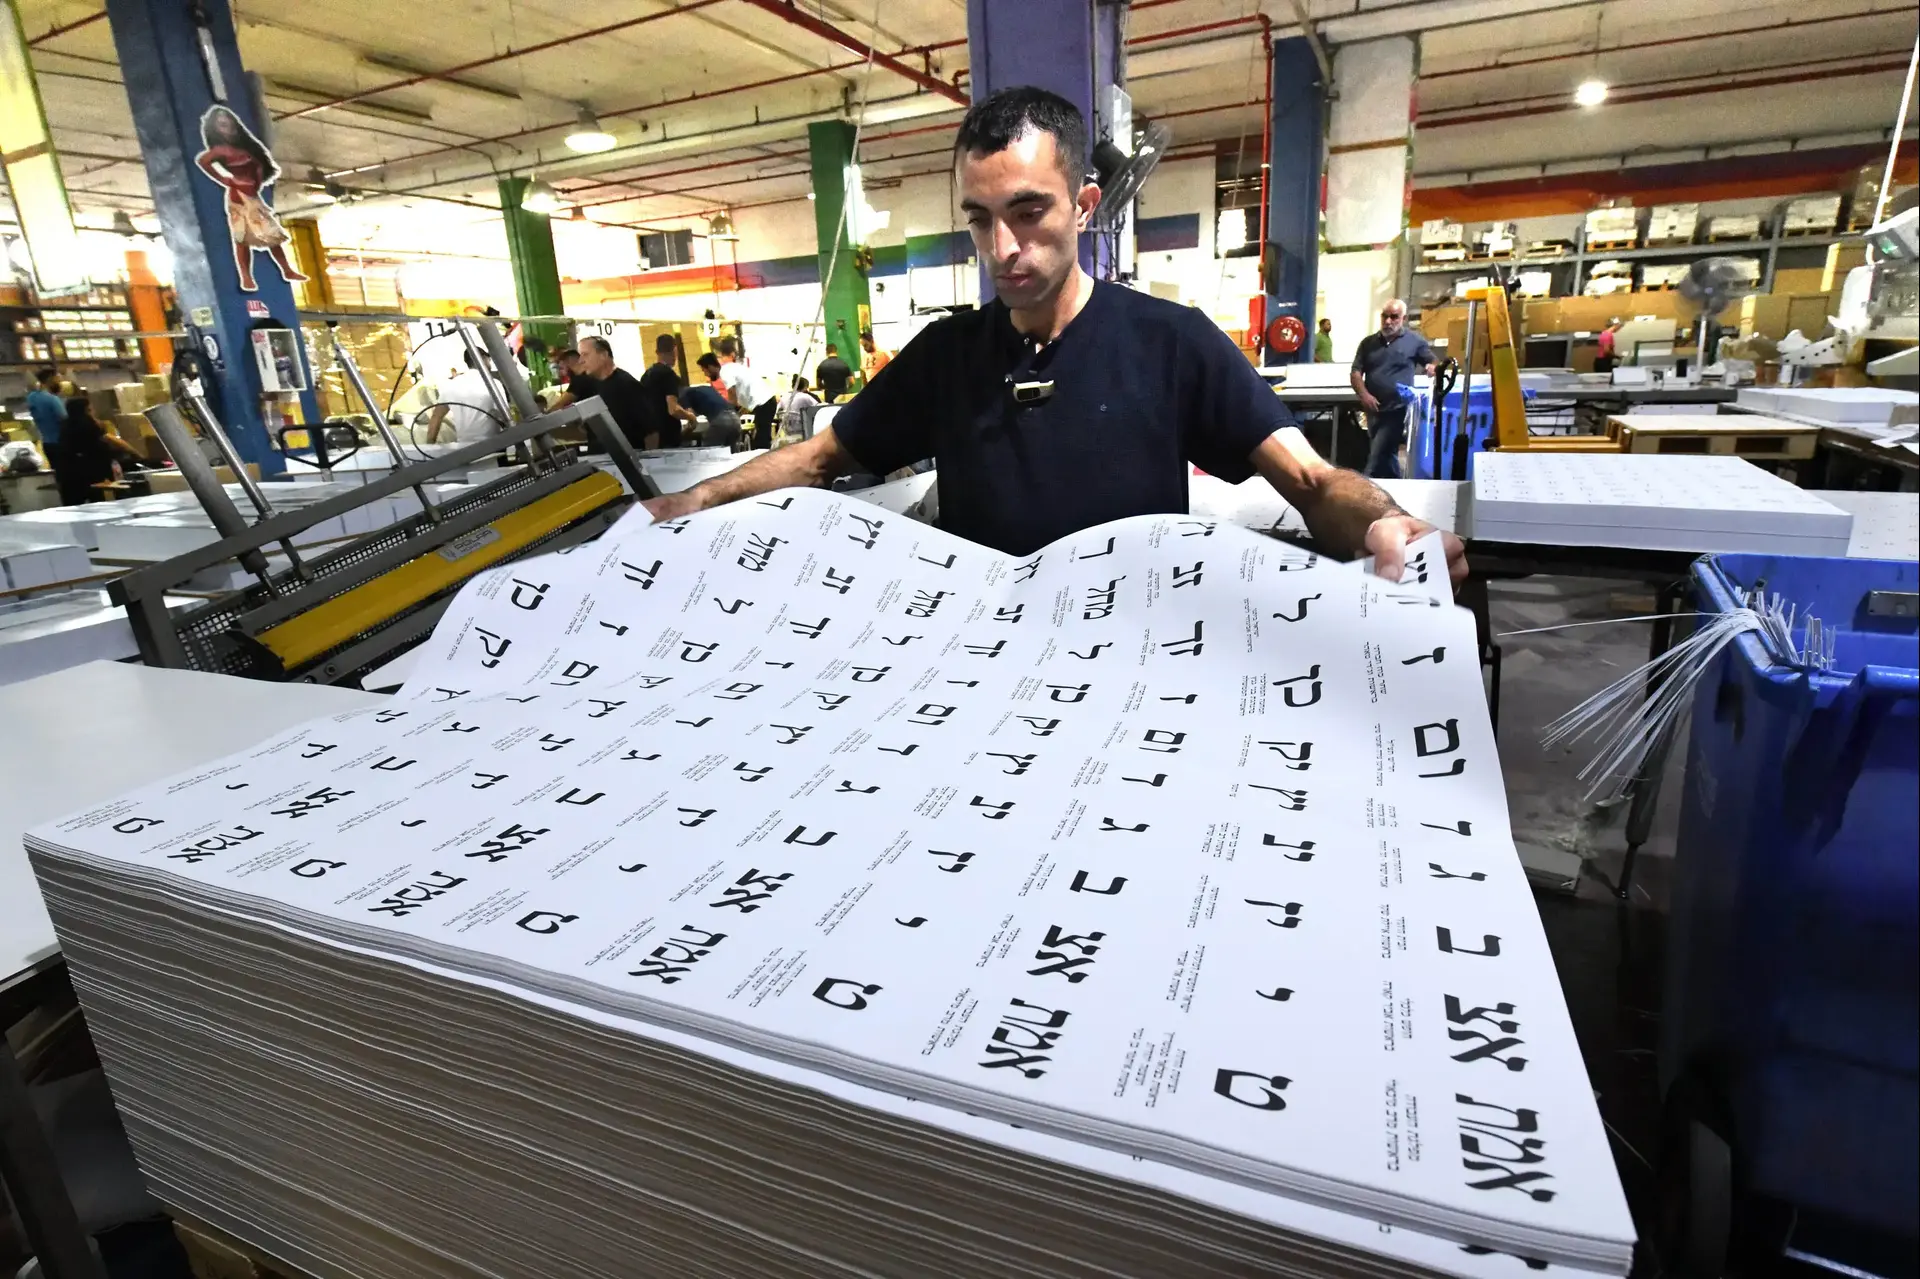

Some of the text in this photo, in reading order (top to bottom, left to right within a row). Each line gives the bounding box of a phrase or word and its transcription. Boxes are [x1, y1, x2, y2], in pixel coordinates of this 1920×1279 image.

[597, 322, 613, 335] 10
[707, 324, 715, 335] 9
[454, 529, 493, 550] POLAR
[737, 533, 789, 572] מחל
[714, 598, 754, 614] ל
[905, 590, 955, 617] מחל
[1083, 575, 1126, 620] מחל
[1273, 593, 1322, 622] ל
[882, 636, 923, 645] ל
[1068, 642, 1113, 659] ל
[1402, 647, 1446, 665] ז
[1046, 684, 1091, 702] כן
[1272, 665, 1322, 707] כן
[1160, 694, 1198, 704] ז
[908, 704, 957, 725] ום
[1016, 716, 1061, 736] יק
[1139, 729, 1187, 753] ום
[1414, 719, 1466, 778] ום
[1258, 741, 1313, 770] יק
[835, 780, 880, 793] ג
[783, 825, 837, 846] ב
[1099, 817, 1150, 832] ג
[290, 859, 347, 878] ט
[1429, 863, 1487, 881] ג
[368, 871, 468, 917] אמת
[709, 868, 794, 913] אצ
[1070, 870, 1128, 895] ב
[516, 911, 579, 934] ט
[895, 917, 928, 928] י
[1436, 926, 1501, 956] ב
[628, 925, 728, 984] אמת
[1026, 925, 1106, 983] אצ
[812, 978, 883, 1010] ט
[1256, 988, 1295, 1001] י
[978, 998, 1071, 1079] אמת
[1444, 994, 1528, 1072] אצ
[1214, 1068, 1292, 1111] ט
[1456, 1093, 1556, 1202] אמת
